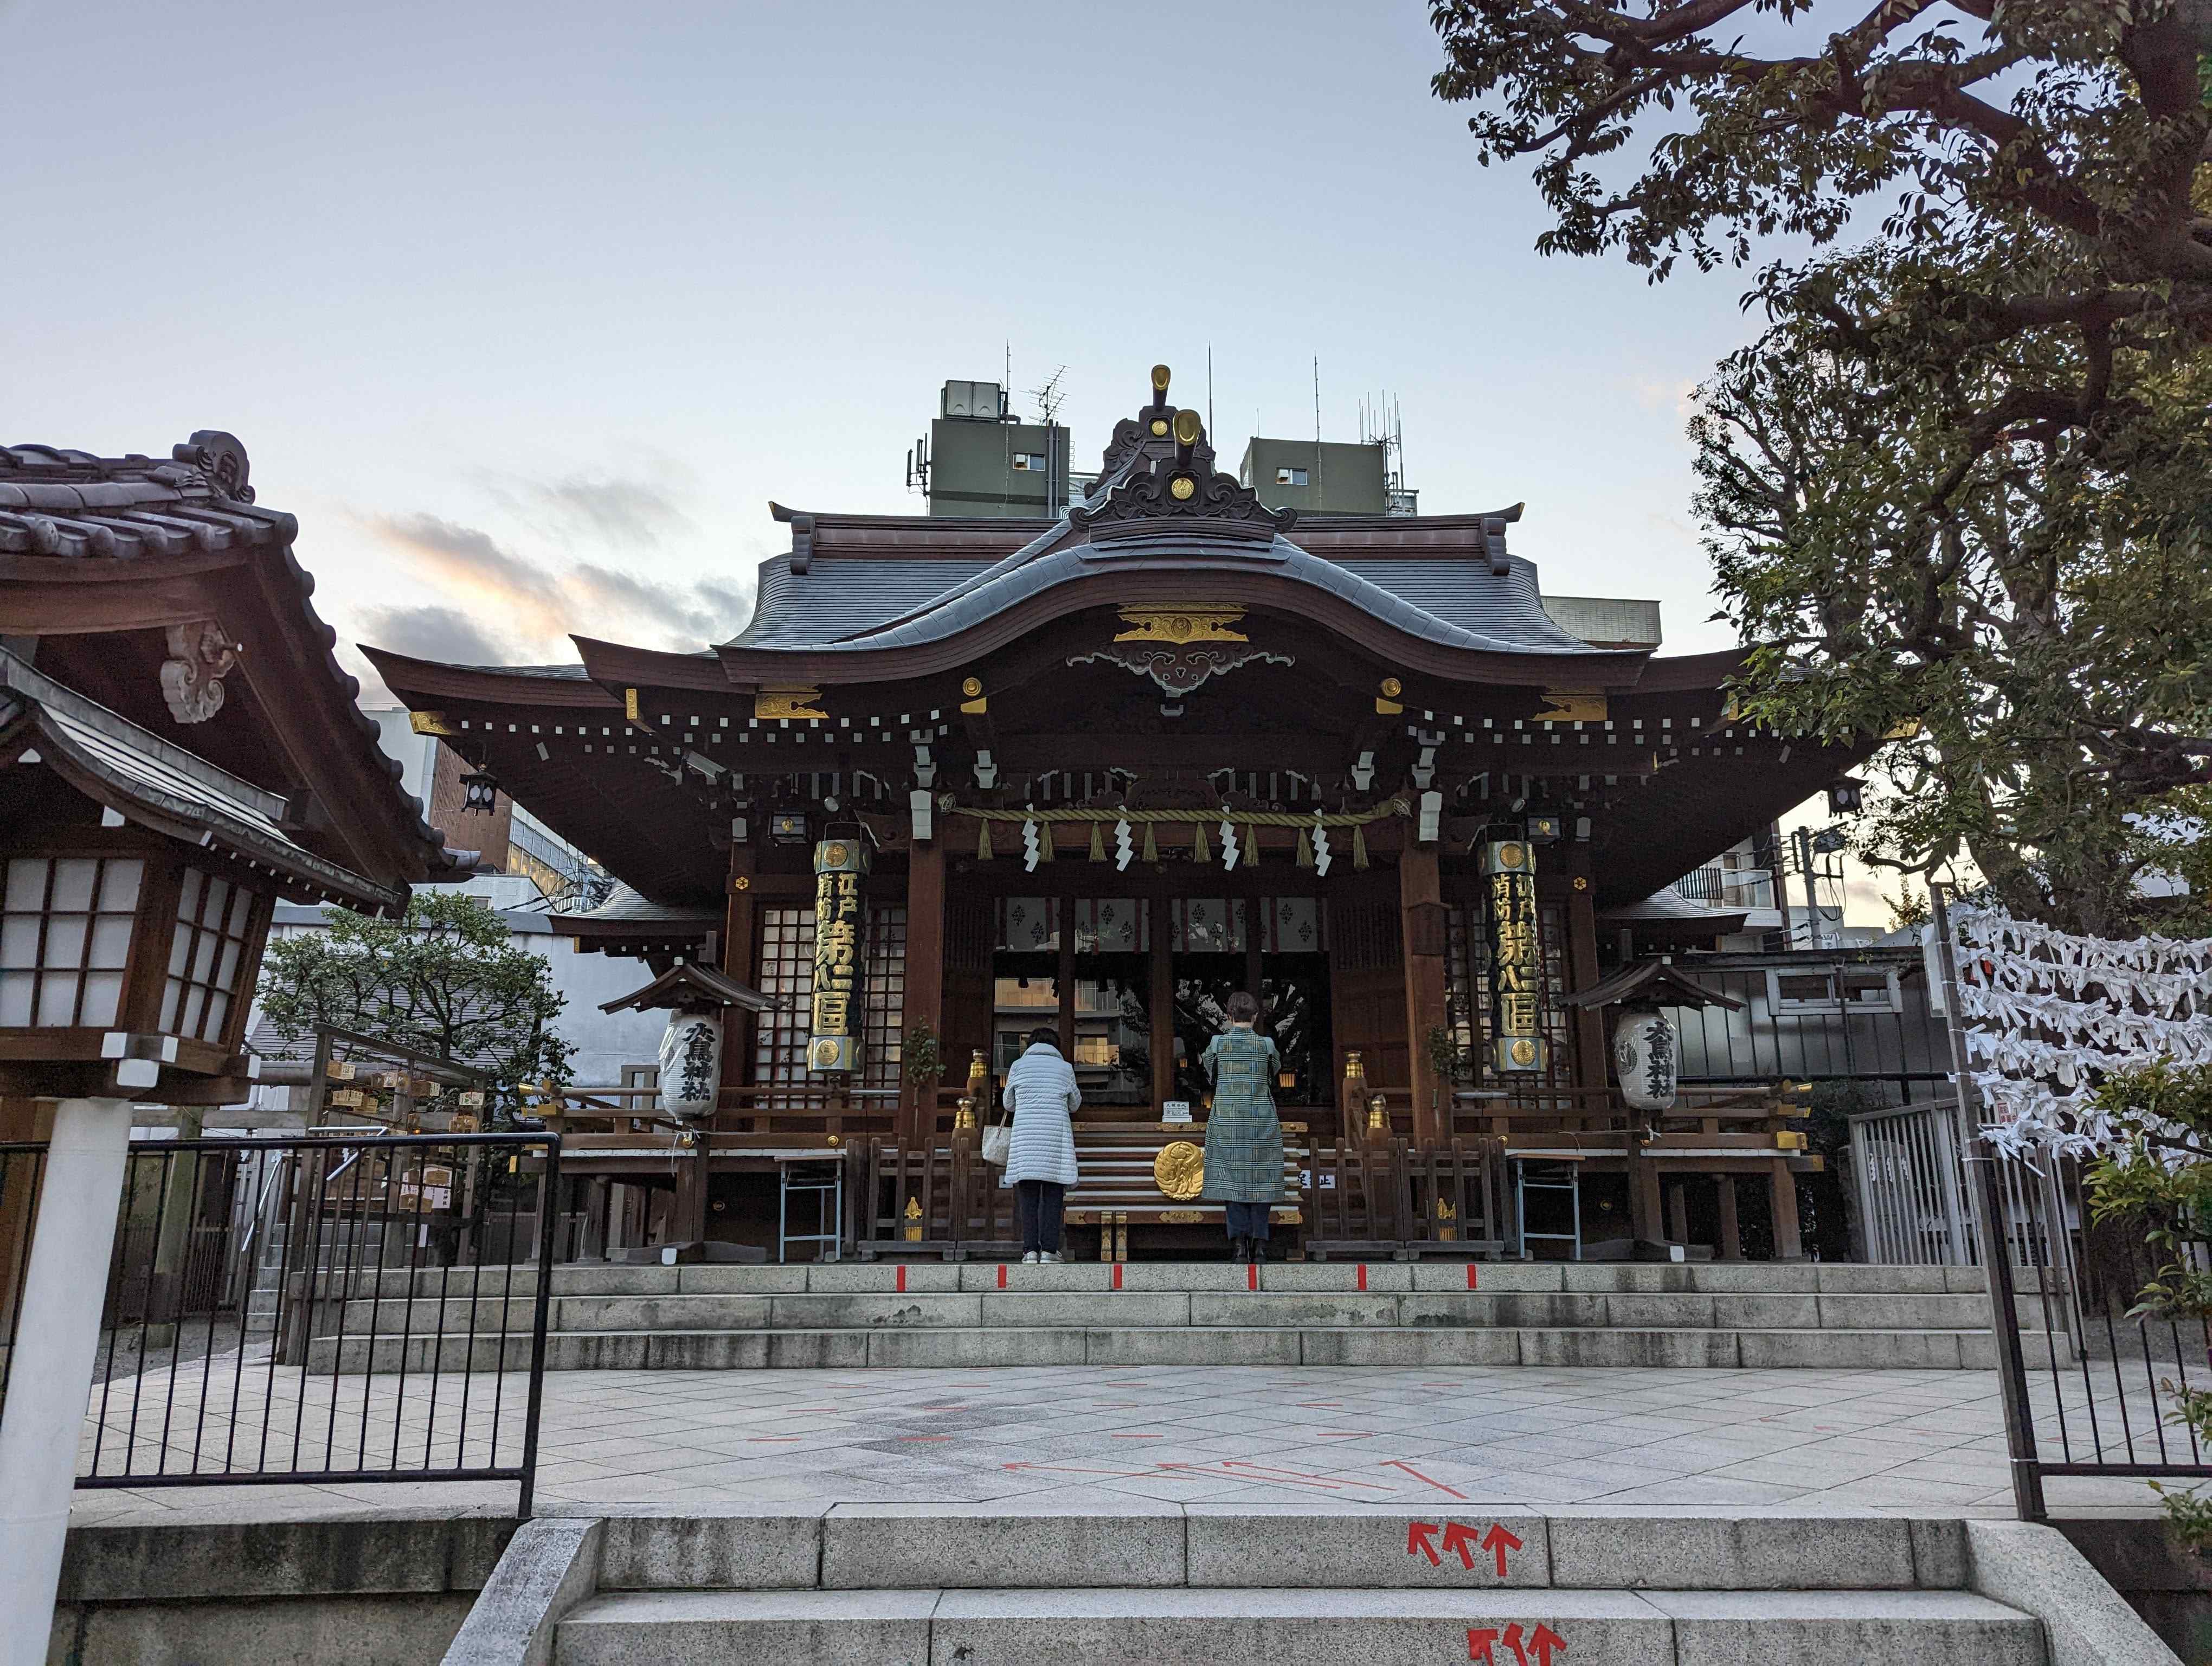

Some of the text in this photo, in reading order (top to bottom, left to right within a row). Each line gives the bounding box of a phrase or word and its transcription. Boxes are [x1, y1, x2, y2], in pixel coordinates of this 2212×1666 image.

[678, 1022, 716, 1102] 大鳥神社
[1642, 1021, 1675, 1100] 大鳥神社
